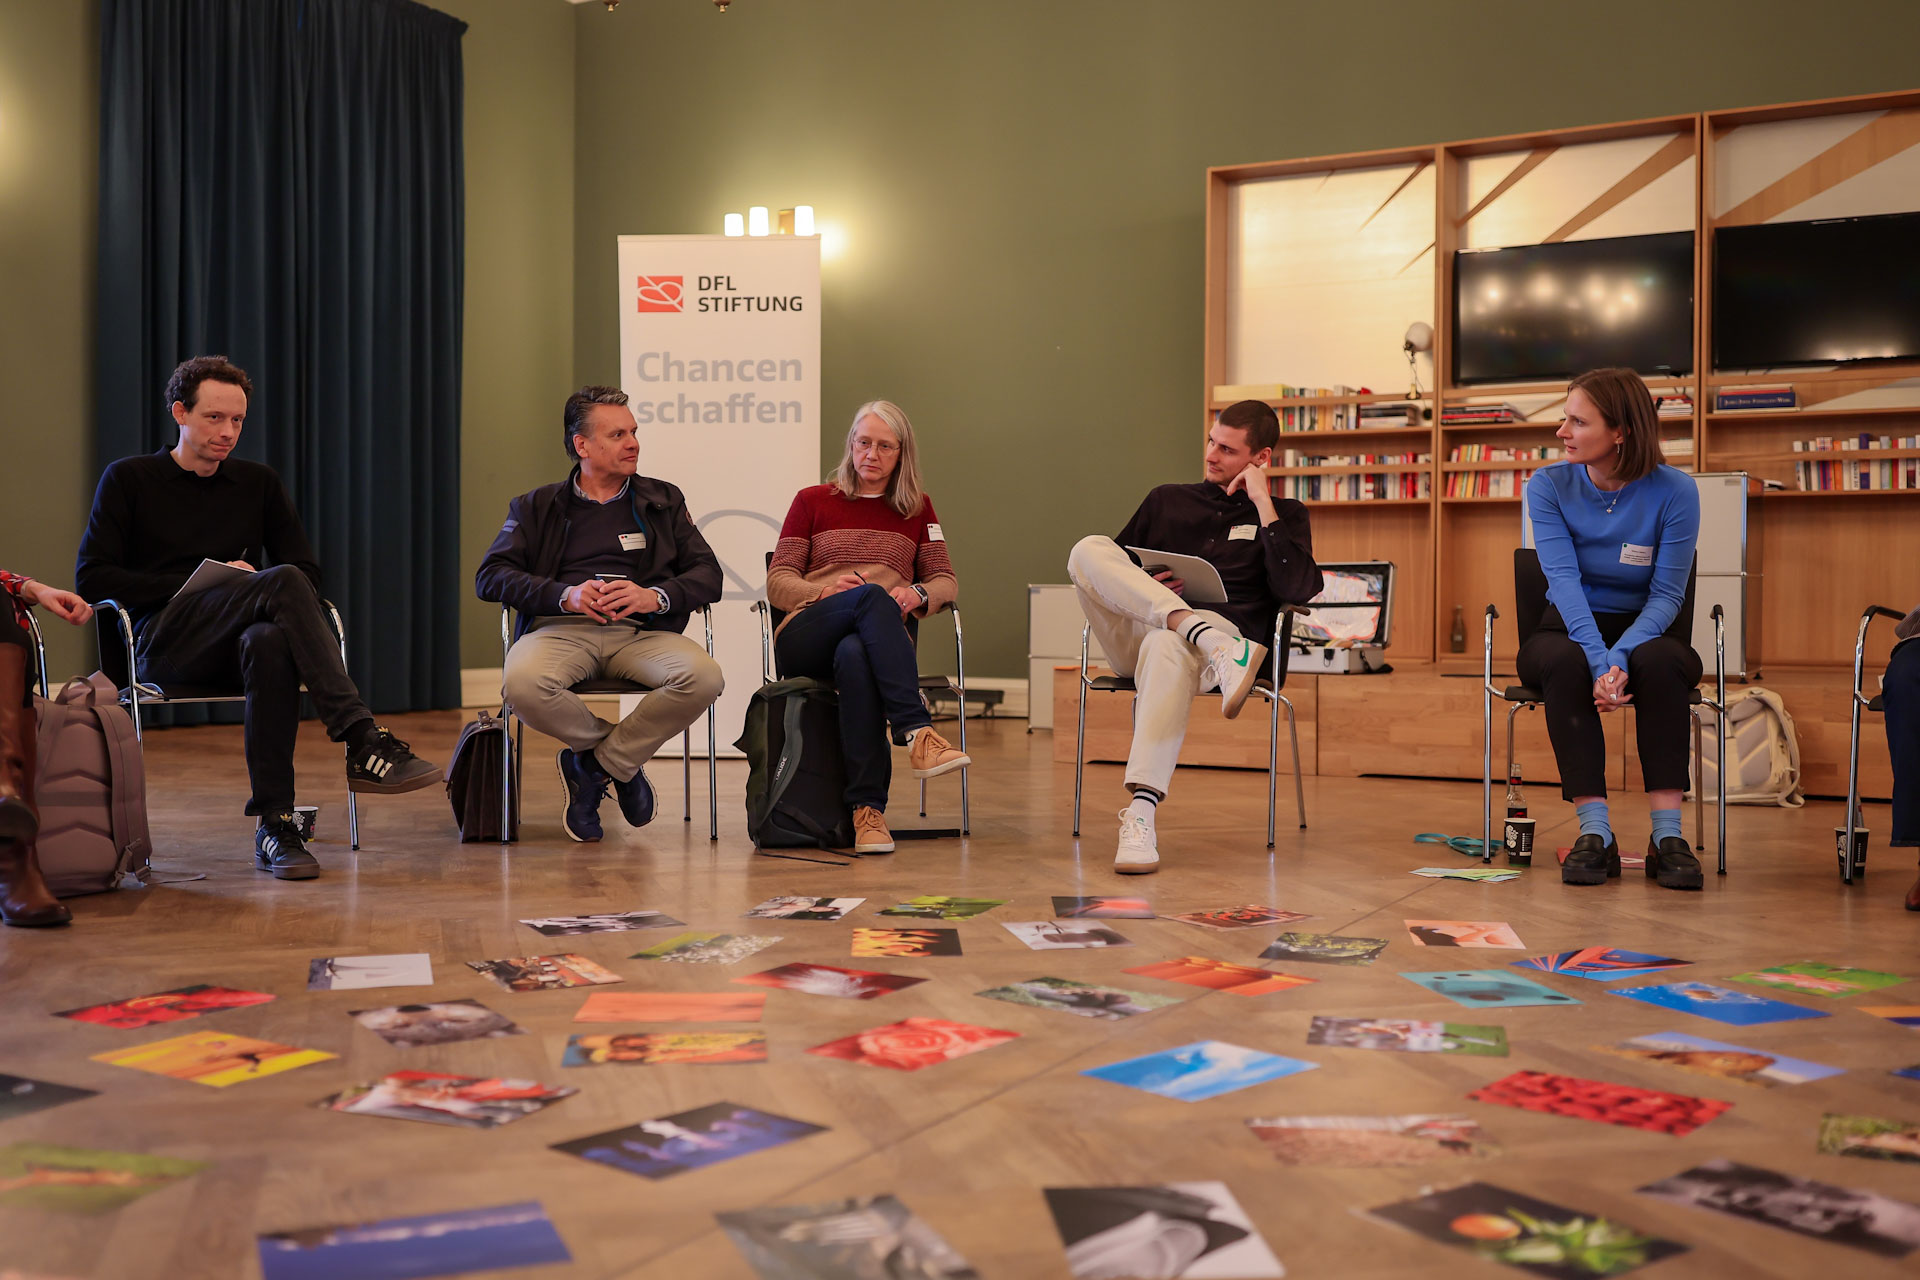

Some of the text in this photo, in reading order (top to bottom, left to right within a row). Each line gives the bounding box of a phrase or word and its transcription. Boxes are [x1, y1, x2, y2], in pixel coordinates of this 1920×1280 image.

[698, 275, 737, 291] DFL
[698, 296, 803, 312] STIFTUNG
[637, 351, 802, 382] Chancen
[637, 392, 802, 424] schaffen
